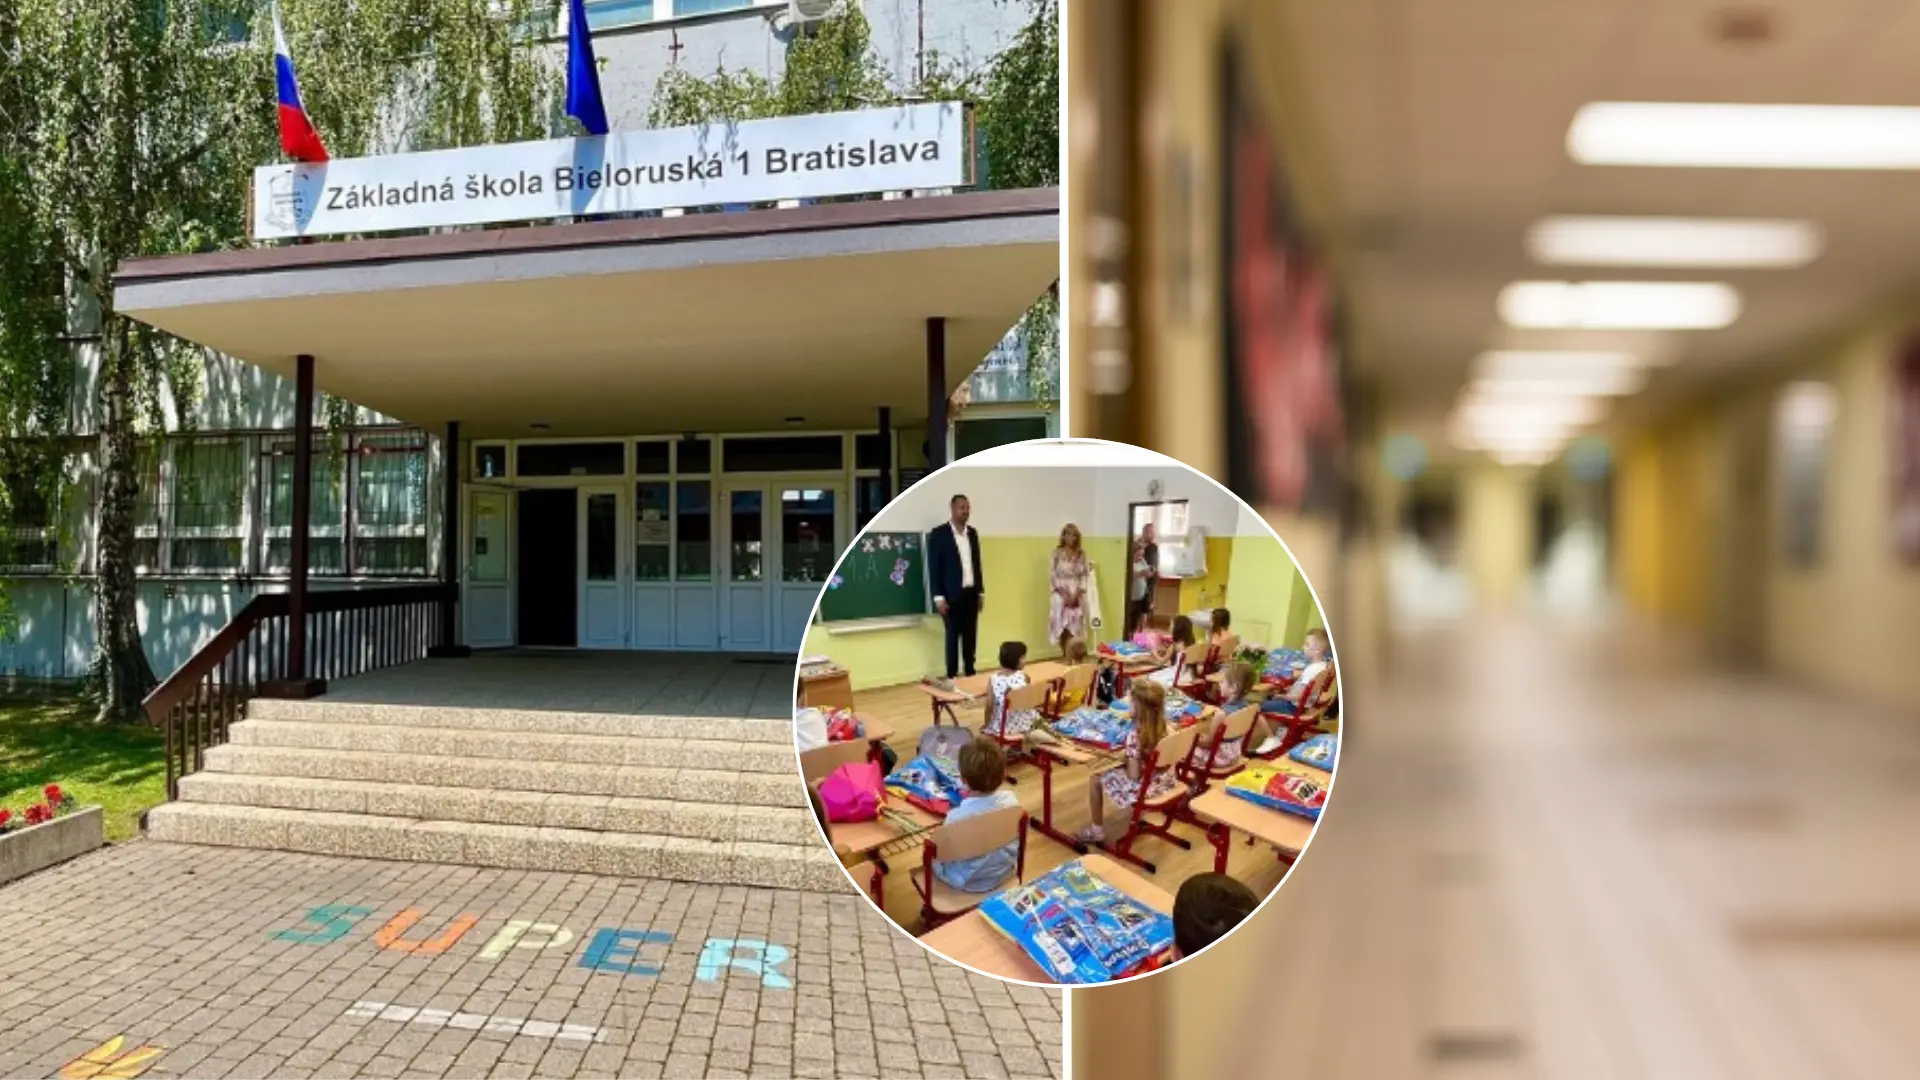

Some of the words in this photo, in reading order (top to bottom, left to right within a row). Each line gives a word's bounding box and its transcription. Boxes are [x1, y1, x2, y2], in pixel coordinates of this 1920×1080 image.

[327, 176, 454, 210] Základná
[465, 170, 543, 199] škola
[555, 153, 723, 191] Bieloruská
[736, 150, 750, 176] 1
[765, 138, 940, 175] Bratislava
[265, 903, 794, 989] SUPER
